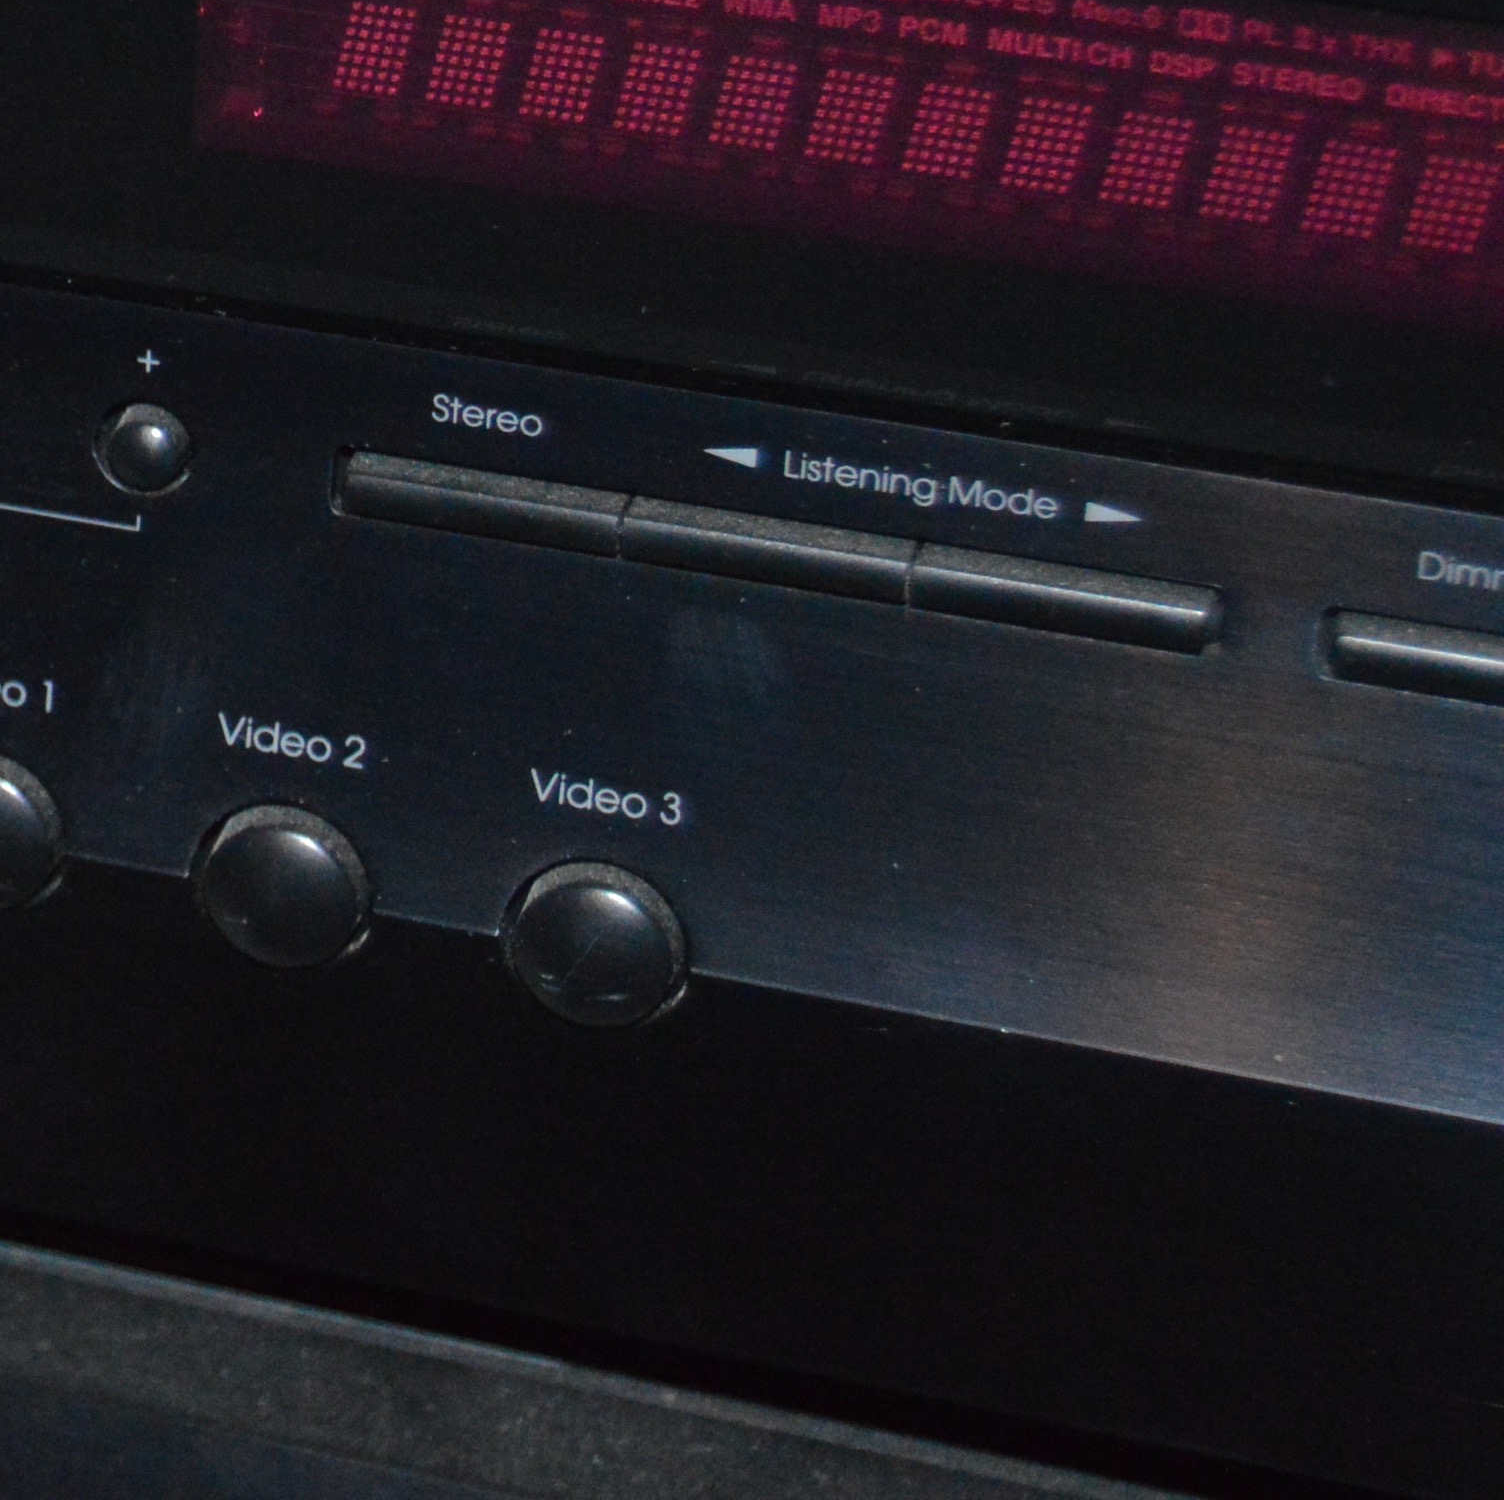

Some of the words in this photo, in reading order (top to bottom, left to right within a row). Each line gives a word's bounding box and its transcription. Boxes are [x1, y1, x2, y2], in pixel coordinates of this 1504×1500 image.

[818, 3, 883, 35] MP3
[898, 14, 968, 47] PCM
[987, 27, 1083, 63] MULTI
[1149, 49, 1218, 80] DSP
[1231, 60, 1366, 102] STEREO
[432, 393, 543, 437] Stereo
[783, 449, 938, 507] Listening
[948, 475, 1059, 520] Mode
[43, 680, 57, 713] 1
[217, 711, 333, 764] Video
[342, 735, 367, 770] 2
[530, 767, 649, 822] Video
[659, 792, 683, 826] 3
